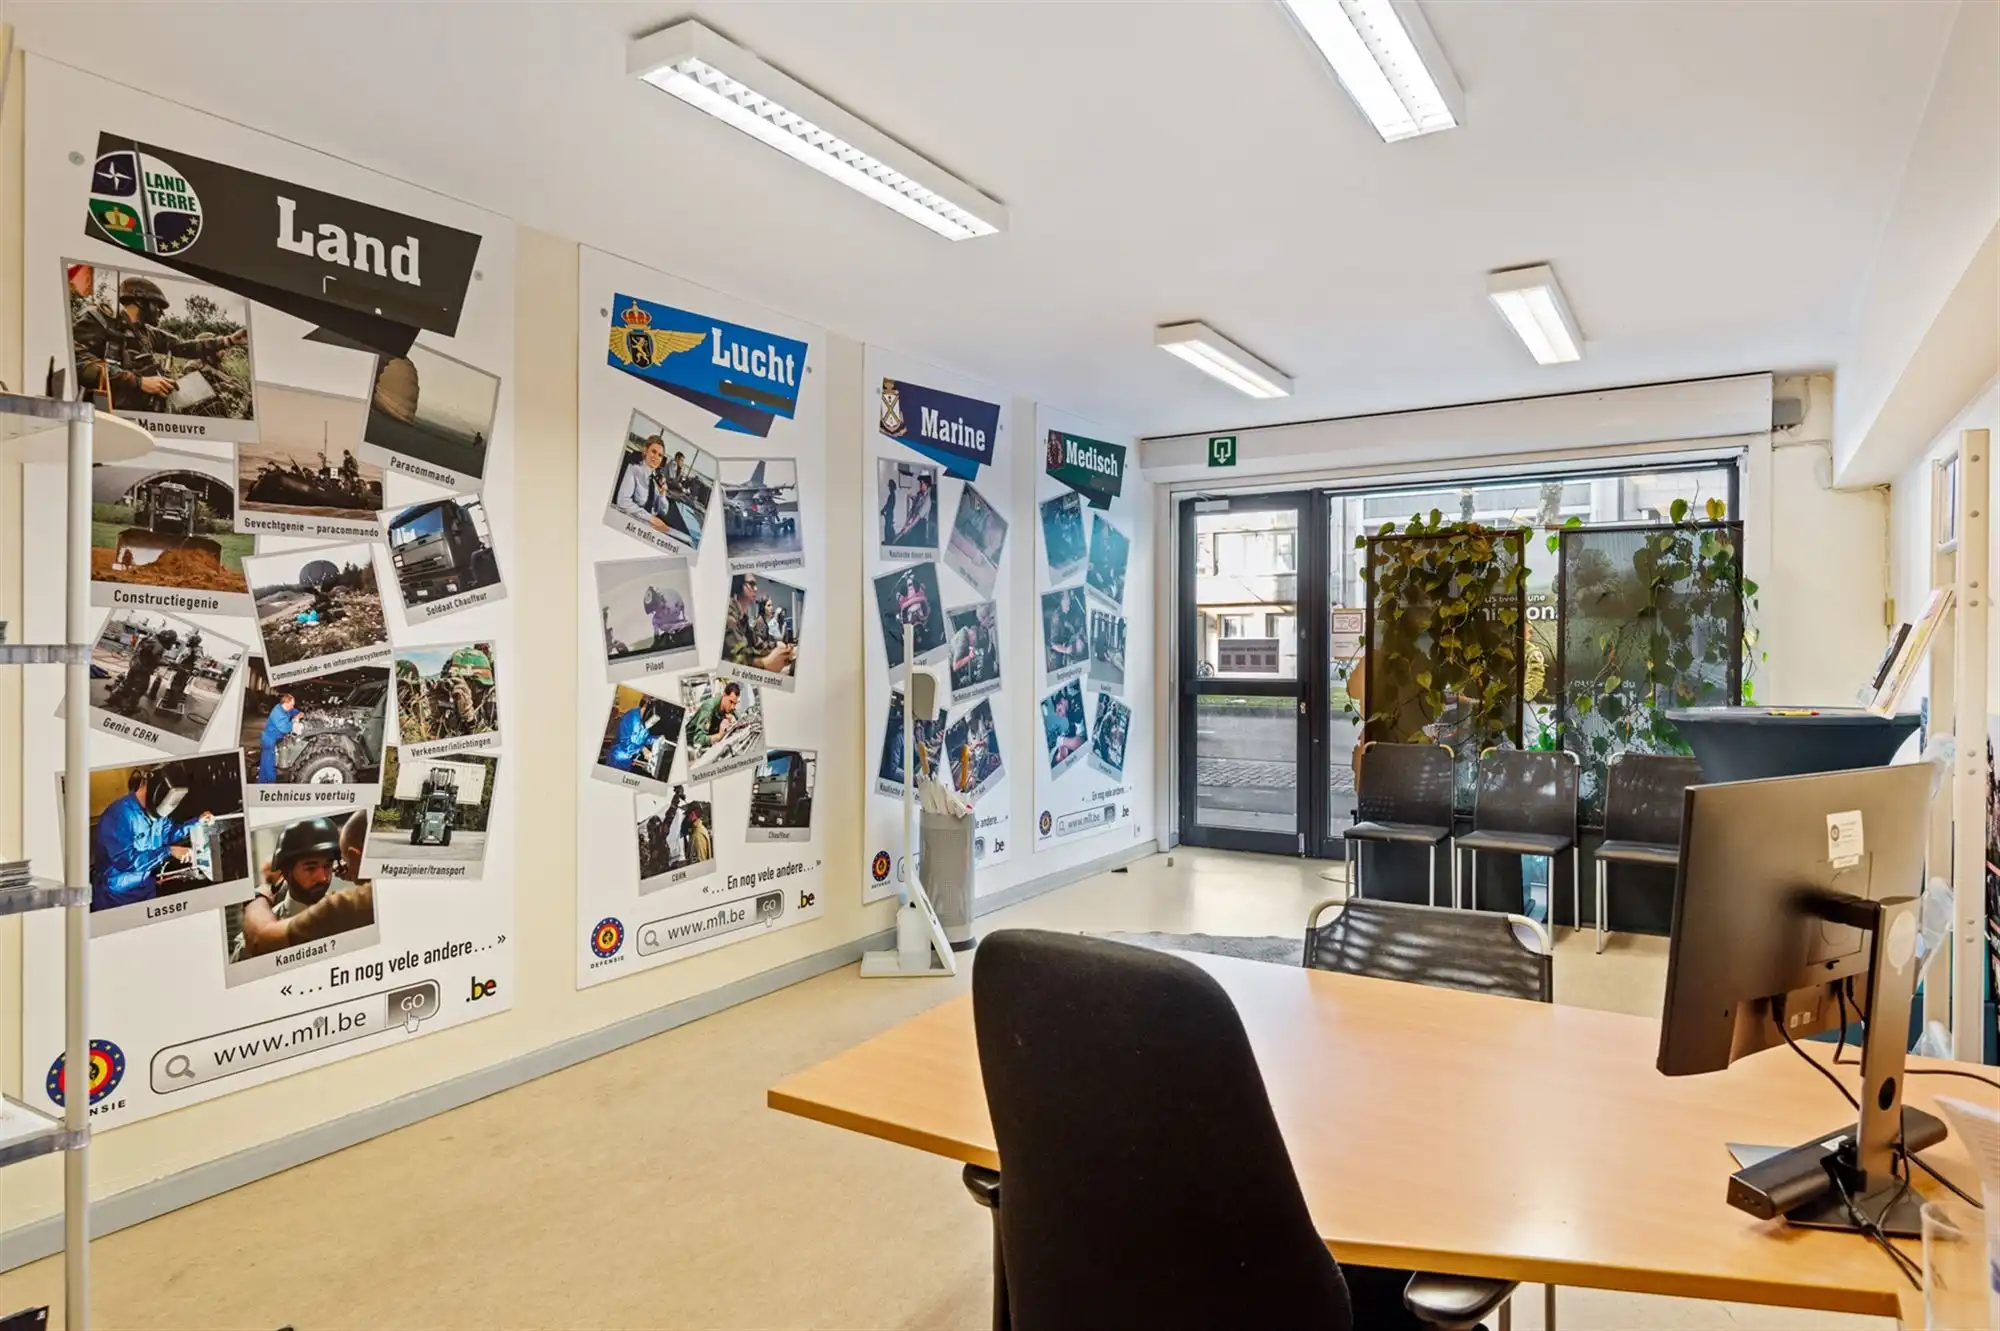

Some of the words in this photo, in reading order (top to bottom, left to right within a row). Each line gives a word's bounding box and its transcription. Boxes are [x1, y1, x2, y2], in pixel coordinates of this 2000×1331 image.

[145, 172, 187, 194] LAND
[148, 190, 197, 212] TERRE
[276, 196, 422, 287] Land
[711, 327, 795, 387] Lucht
[138, 418, 206, 435] Manoeuvre
[920, 406, 986, 451] Marine
[1065, 440, 1119, 477] Medisch
[389, 456, 456, 486] Paracommando
[244, 517, 304, 532] Gevechtgenie
[316, 524, 379, 537] paracommando
[625, 521, 637, 533] Air
[656, 538, 680, 554] control
[113, 590, 220, 611] Constructiegenie
[425, 602, 453, 616] Soldaat
[453, 592, 488, 608] Chauffeur
[1527, 594, 1546, 602] une
[271, 663, 322, 681] Communicatie-
[323, 662, 332, 670] en
[645, 661, 665, 673] Piloot
[763, 676, 783, 686] control
[103, 716, 131, 734] Genie
[132, 726, 160, 744] CBRN
[622, 775, 641, 787] Lasser
[259, 789, 312, 802] Technicus
[314, 789, 356, 803] voertuig
[380, 862, 466, 878] Magazijnier/transport
[727, 875, 738, 891] En
[740, 874, 756, 890] nog
[758, 866, 775, 882] vele
[146, 898, 189, 920] Lasser
[762, 899, 777, 912] GO
[797, 889, 816, 910] .be
[667, 908, 746, 941] www.mil.be
[275, 942, 329, 968] Kandidaat
[590, 955, 625, 969] DEFENSIE
[330, 966, 350, 988] En
[355, 961, 384, 982] nog
[388, 950, 420, 974] vele
[465, 976, 498, 1003] .be
[400, 993, 425, 1012] GO
[213, 1011, 367, 1066] www.mil.be
